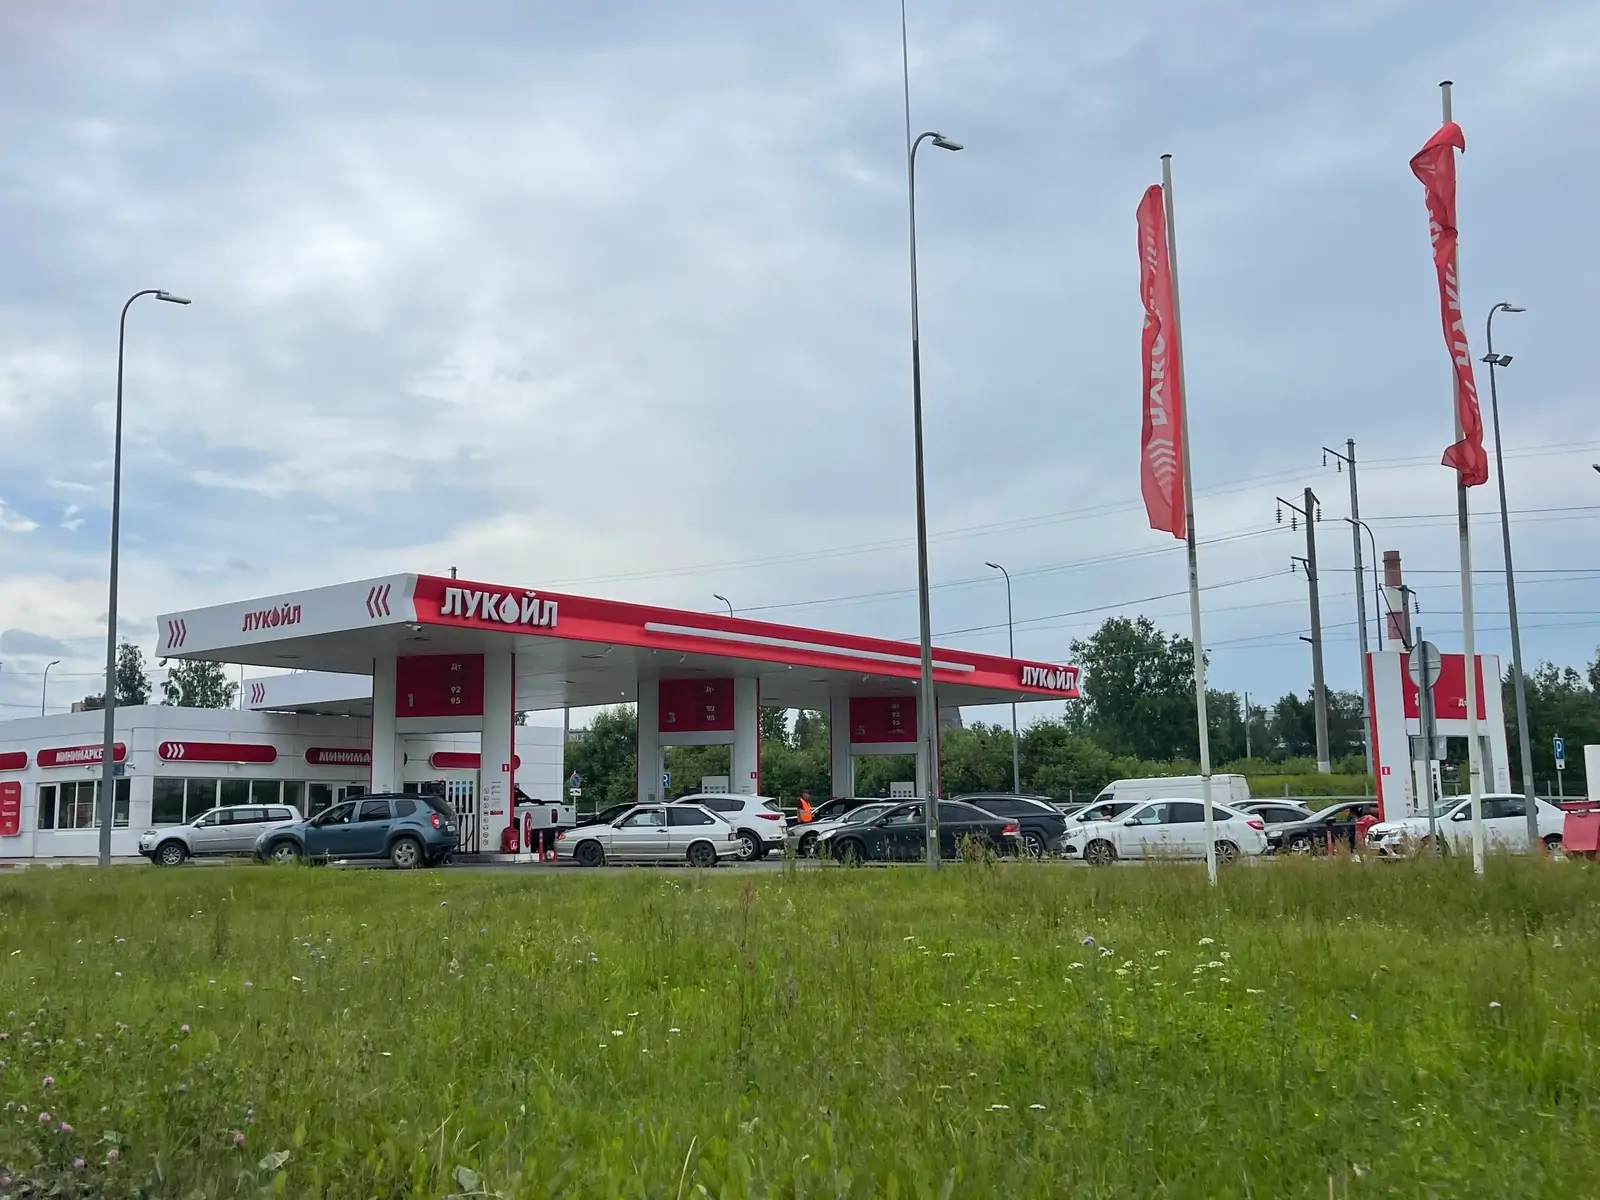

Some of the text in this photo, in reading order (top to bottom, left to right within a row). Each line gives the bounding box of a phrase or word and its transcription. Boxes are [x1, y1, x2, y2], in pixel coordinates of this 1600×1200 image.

[441, 586, 558, 628] ЛУКОЙЛ
[242, 602, 302, 632] ЛУКОЙЛ
[450, 663, 462, 671] Дт
[1021, 665, 1075, 690] ЛУКОЙЛ
[450, 686, 462, 694] 92
[407, 693, 414, 708] 1
[450, 697, 461, 705] 95
[667, 711, 676, 723] 3
[55, 748, 104, 763] МИНИМАРКЕ
[318, 751, 370, 763] МИНИМА
